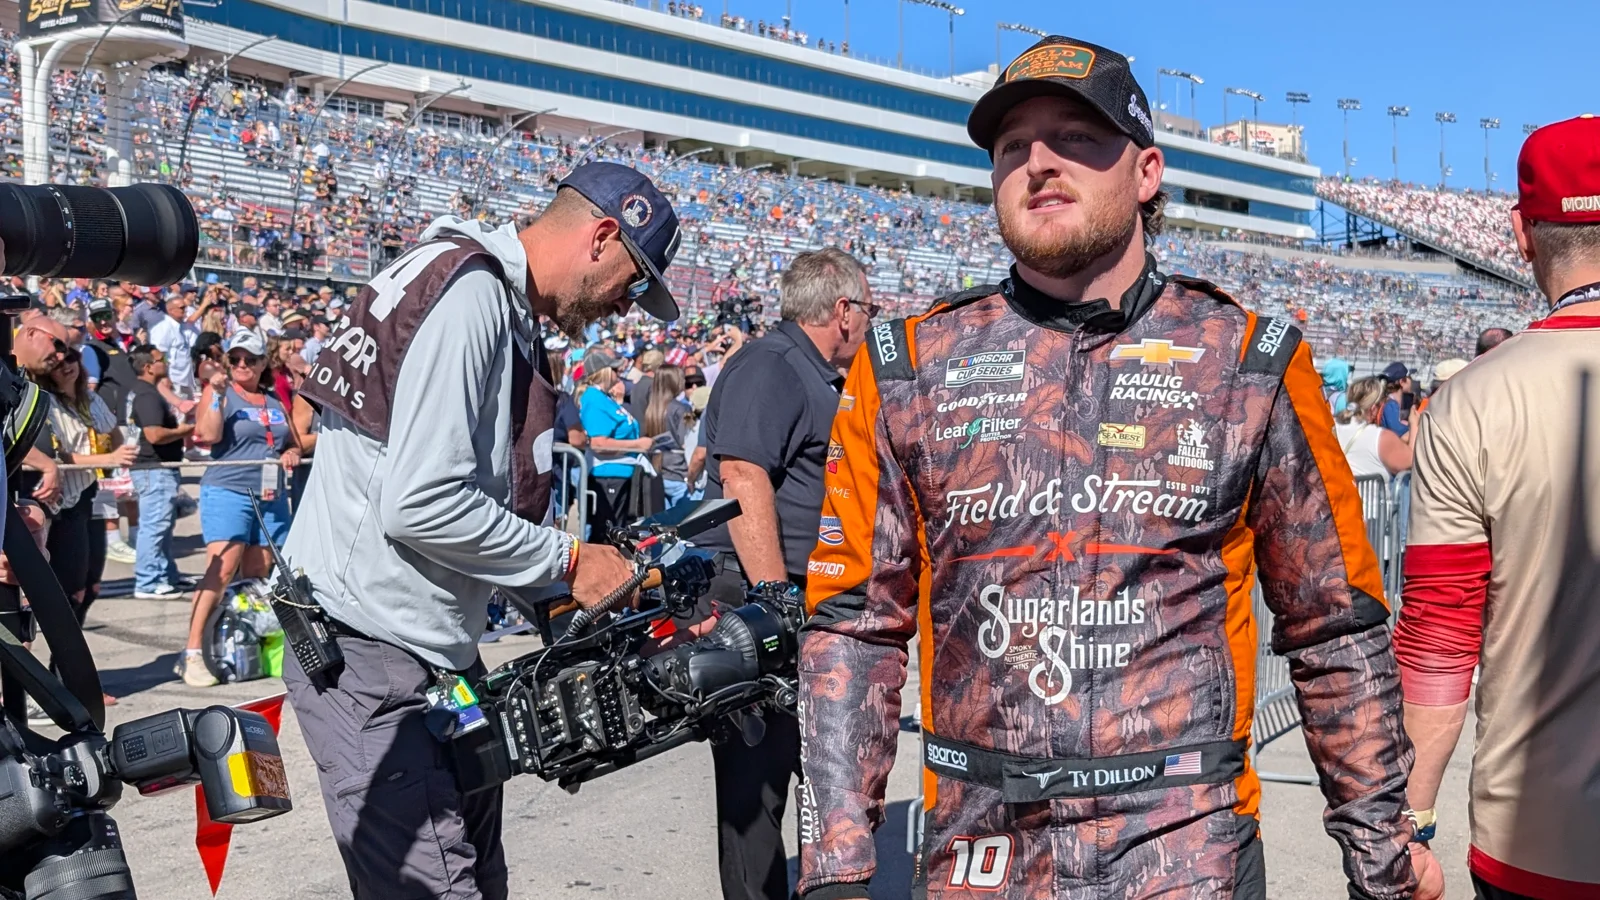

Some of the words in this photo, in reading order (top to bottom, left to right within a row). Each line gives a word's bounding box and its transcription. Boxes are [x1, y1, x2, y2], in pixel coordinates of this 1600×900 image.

[971, 353, 1014, 365] NASCAR
[956, 368, 977, 380] CUP
[977, 366, 1013, 376] SERIES
[1115, 373, 1183, 389] KAULIG
[309, 362, 366, 410] IONS
[1110, 387, 1182, 403] RACING
[1101, 432, 1117, 440] SEA
[1119, 433, 1141, 442] BEST
[1177, 445, 1207, 459] FALLEN
[1167, 454, 1215, 471] OUTDOORS
[1165, 480, 1187, 492] ESTB
[1190, 484, 1211, 496] 1871
[944, 480, 1027, 529] Field
[1029, 478, 1063, 517] &
[1071, 472, 1209, 522] Stream
[977, 583, 1145, 659] Sugarlands
[1009, 645, 1033, 653] SMOKY
[1004, 652, 1038, 663] AUTHENTIC
[1028, 625, 1131, 706] Shine
[927, 742, 968, 772] sparco
[1068, 770, 1089, 788] TY
[1094, 765, 1157, 786] DILLON
[946, 832, 1015, 891] 10
